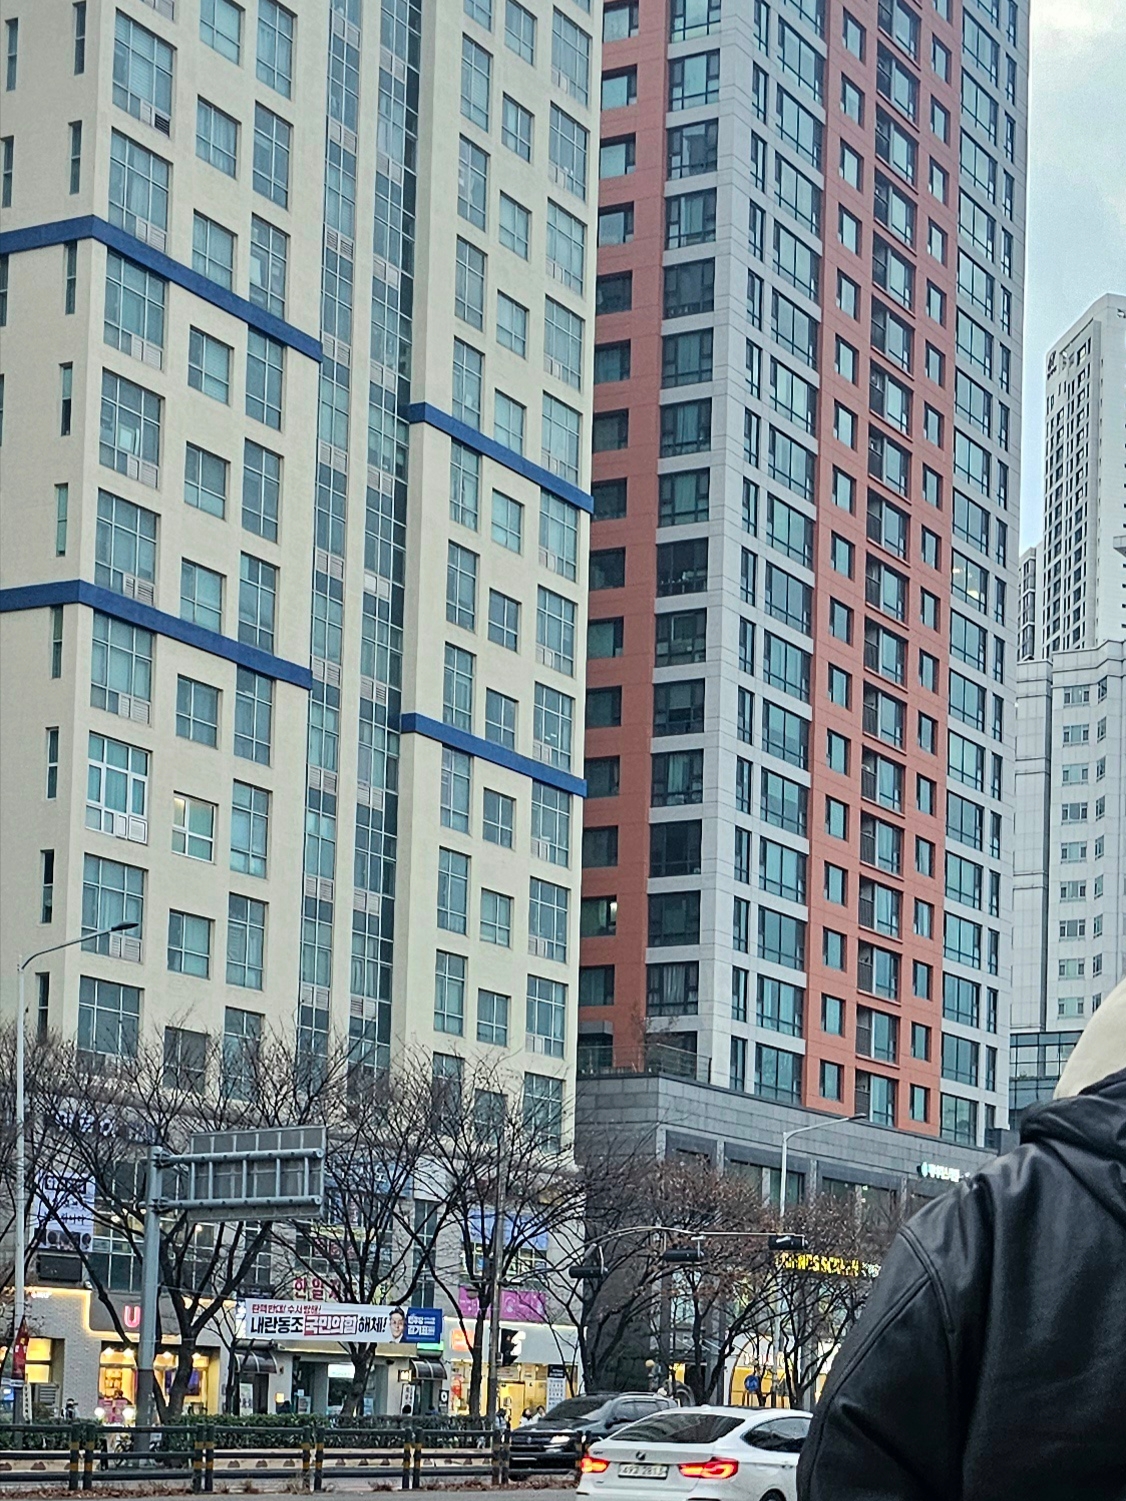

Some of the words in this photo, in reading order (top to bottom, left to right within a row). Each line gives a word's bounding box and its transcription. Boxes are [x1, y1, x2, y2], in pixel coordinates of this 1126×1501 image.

[251, 1316, 304, 1334] 내란동조
[304, 1315, 357, 1335] 국민의힘
[359, 1315, 387, 1333] 해체!
